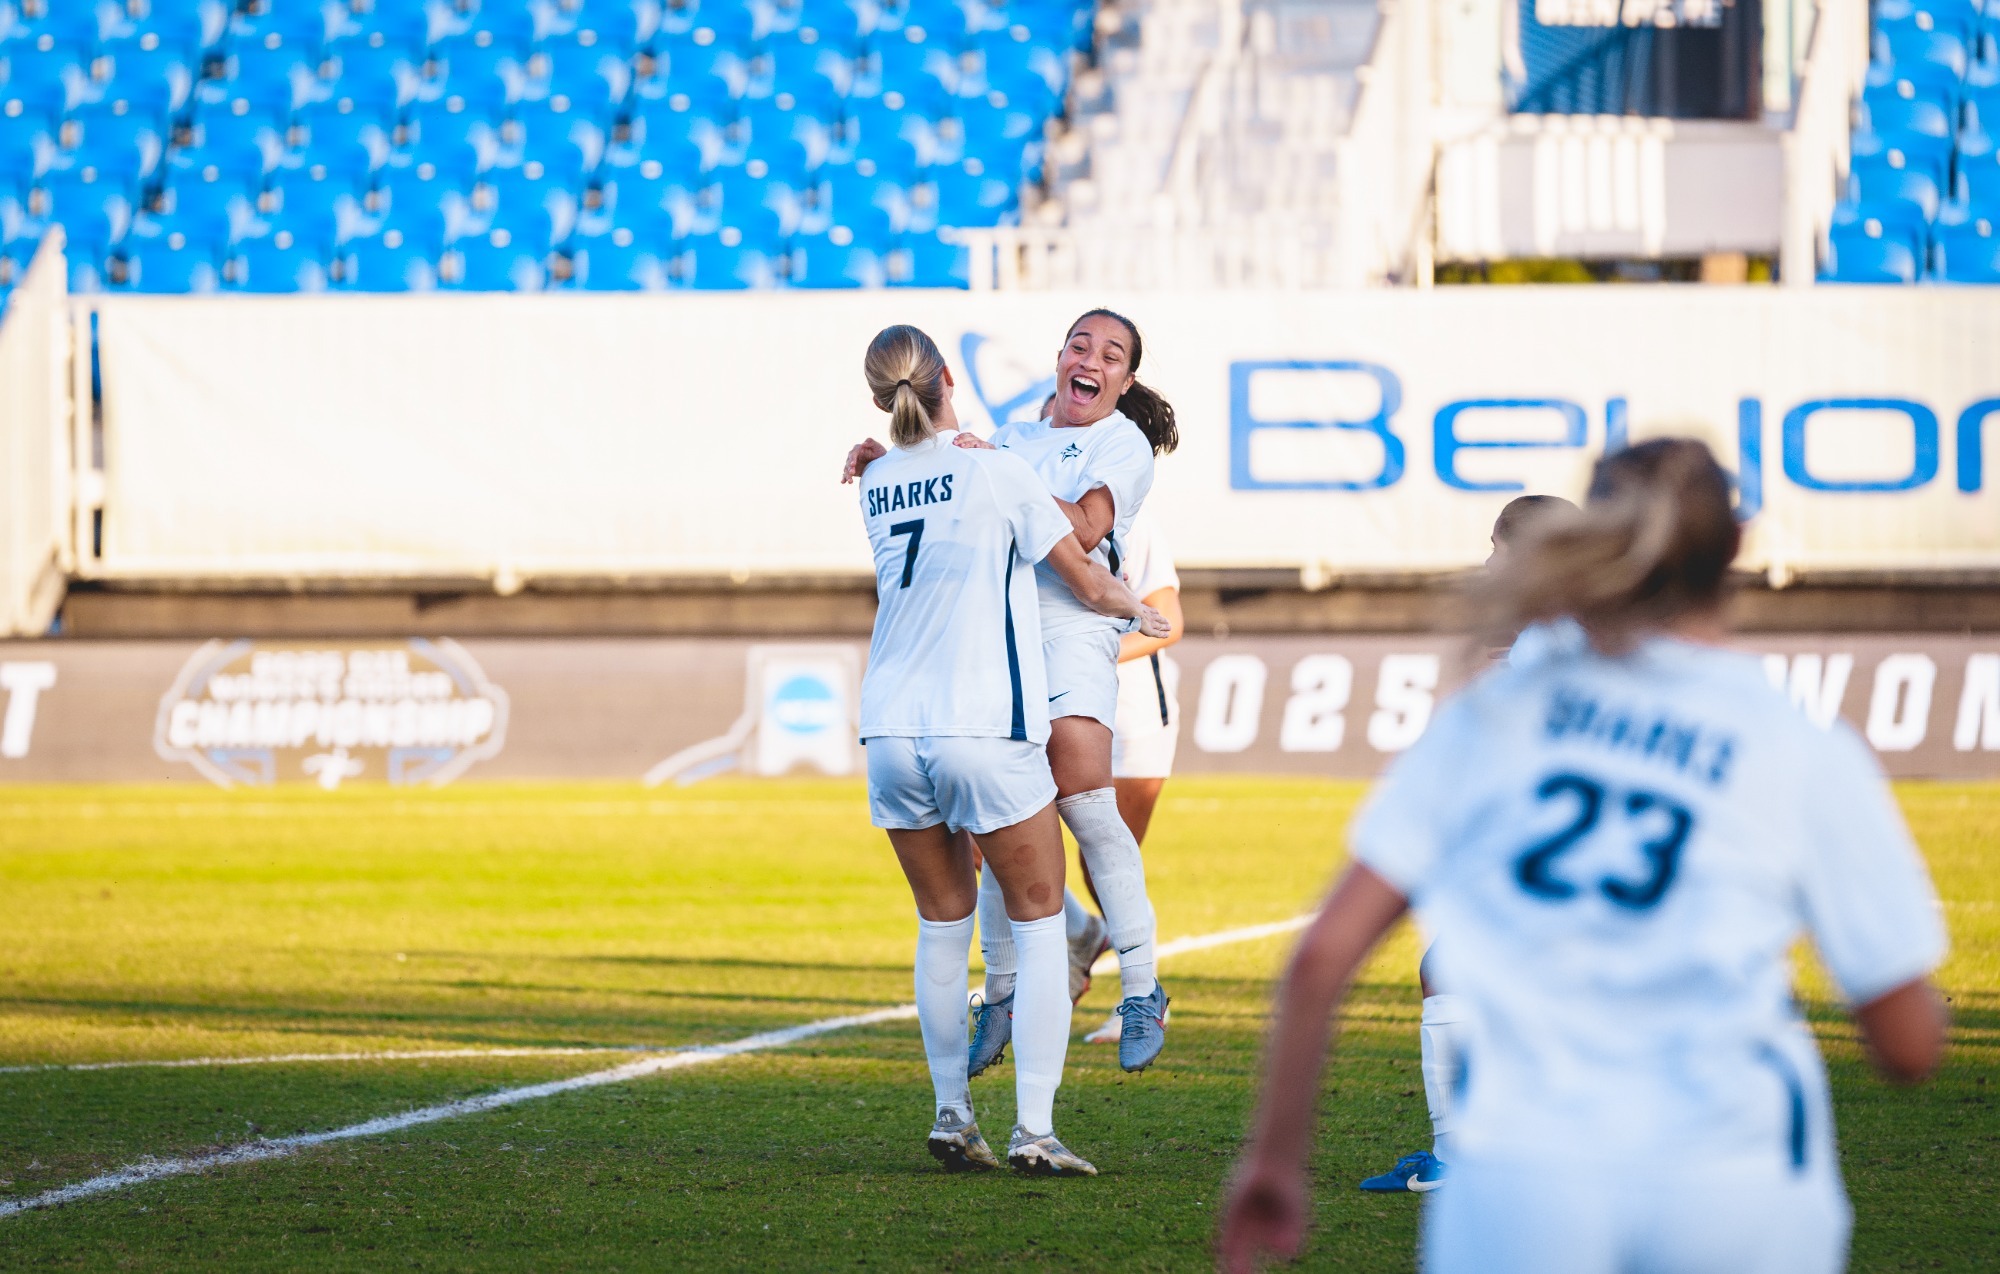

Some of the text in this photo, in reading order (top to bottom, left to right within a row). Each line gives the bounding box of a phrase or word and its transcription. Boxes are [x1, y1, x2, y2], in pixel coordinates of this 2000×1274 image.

[867, 474, 954, 517] SHARKS
[889, 518, 925, 589] 7
[1165, 653, 1440, 752] 025
[1513, 767, 1699, 913] 23
